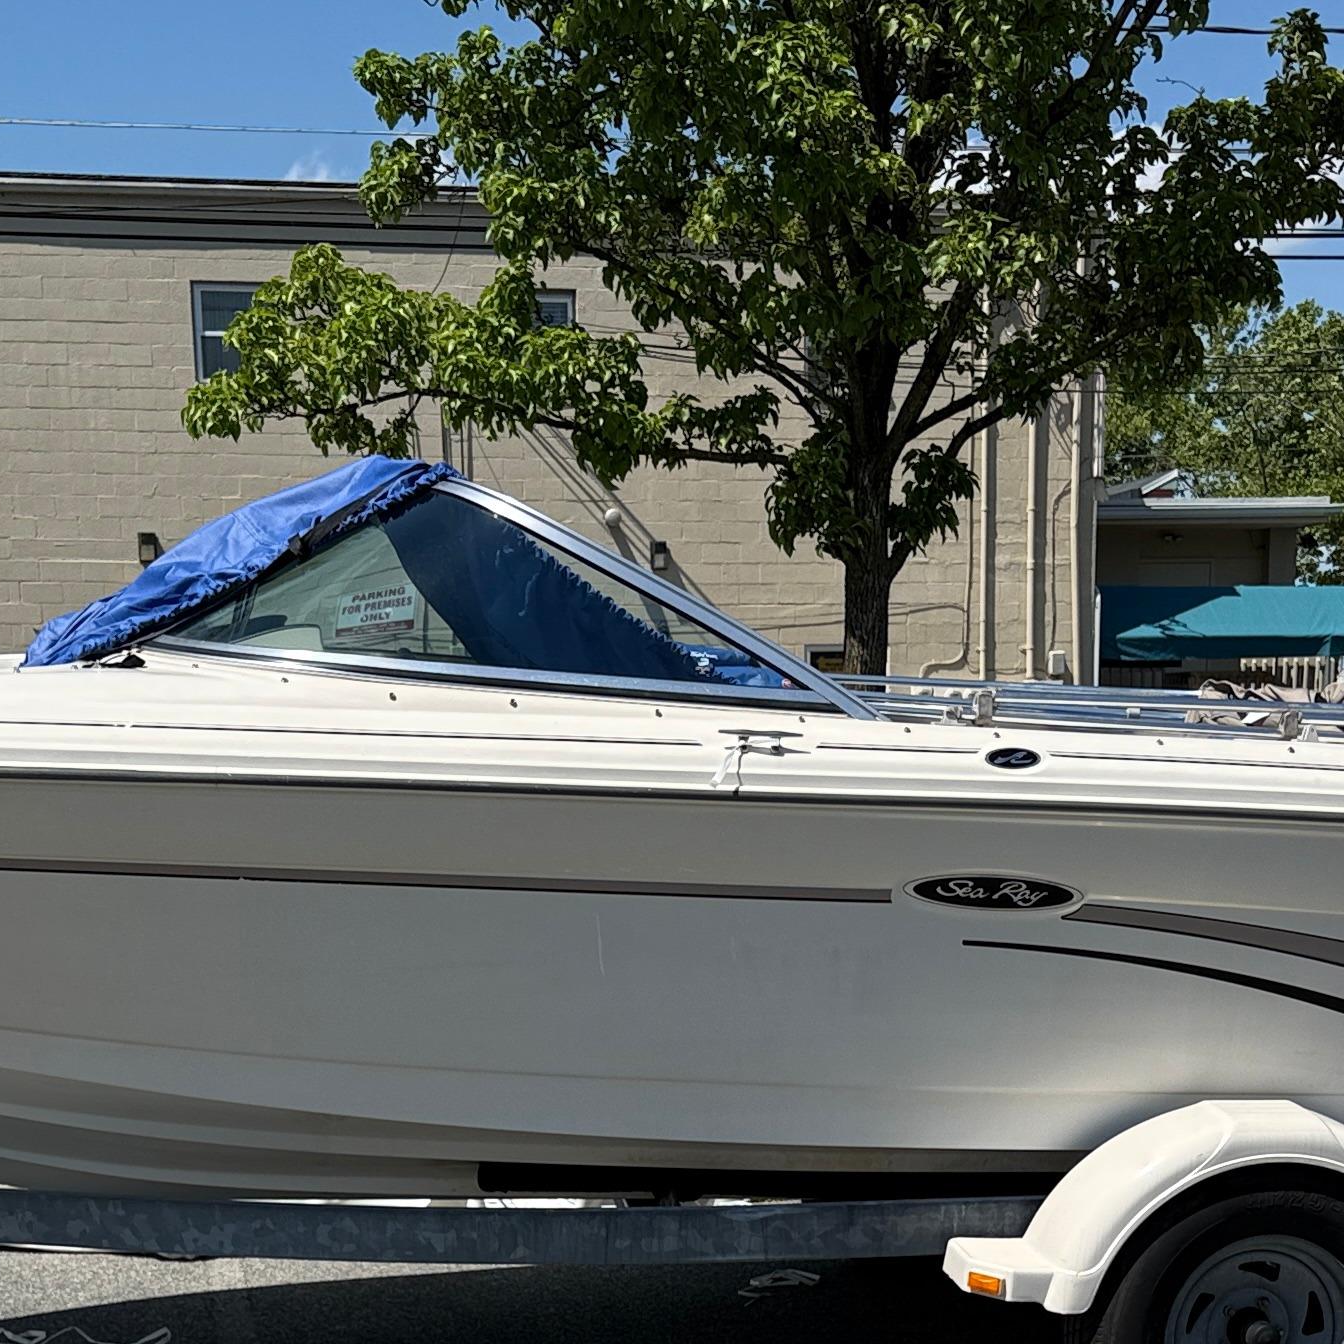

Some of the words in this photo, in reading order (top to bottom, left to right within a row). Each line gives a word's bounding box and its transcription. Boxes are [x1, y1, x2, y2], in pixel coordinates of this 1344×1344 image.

[352, 587, 405, 602] PARKING
[342, 604, 361, 615] FOR
[364, 596, 413, 612] PREMISES
[360, 611, 391, 623] ONLY
[936, 880, 990, 899] Sea
[992, 881, 1048, 907] Ray
